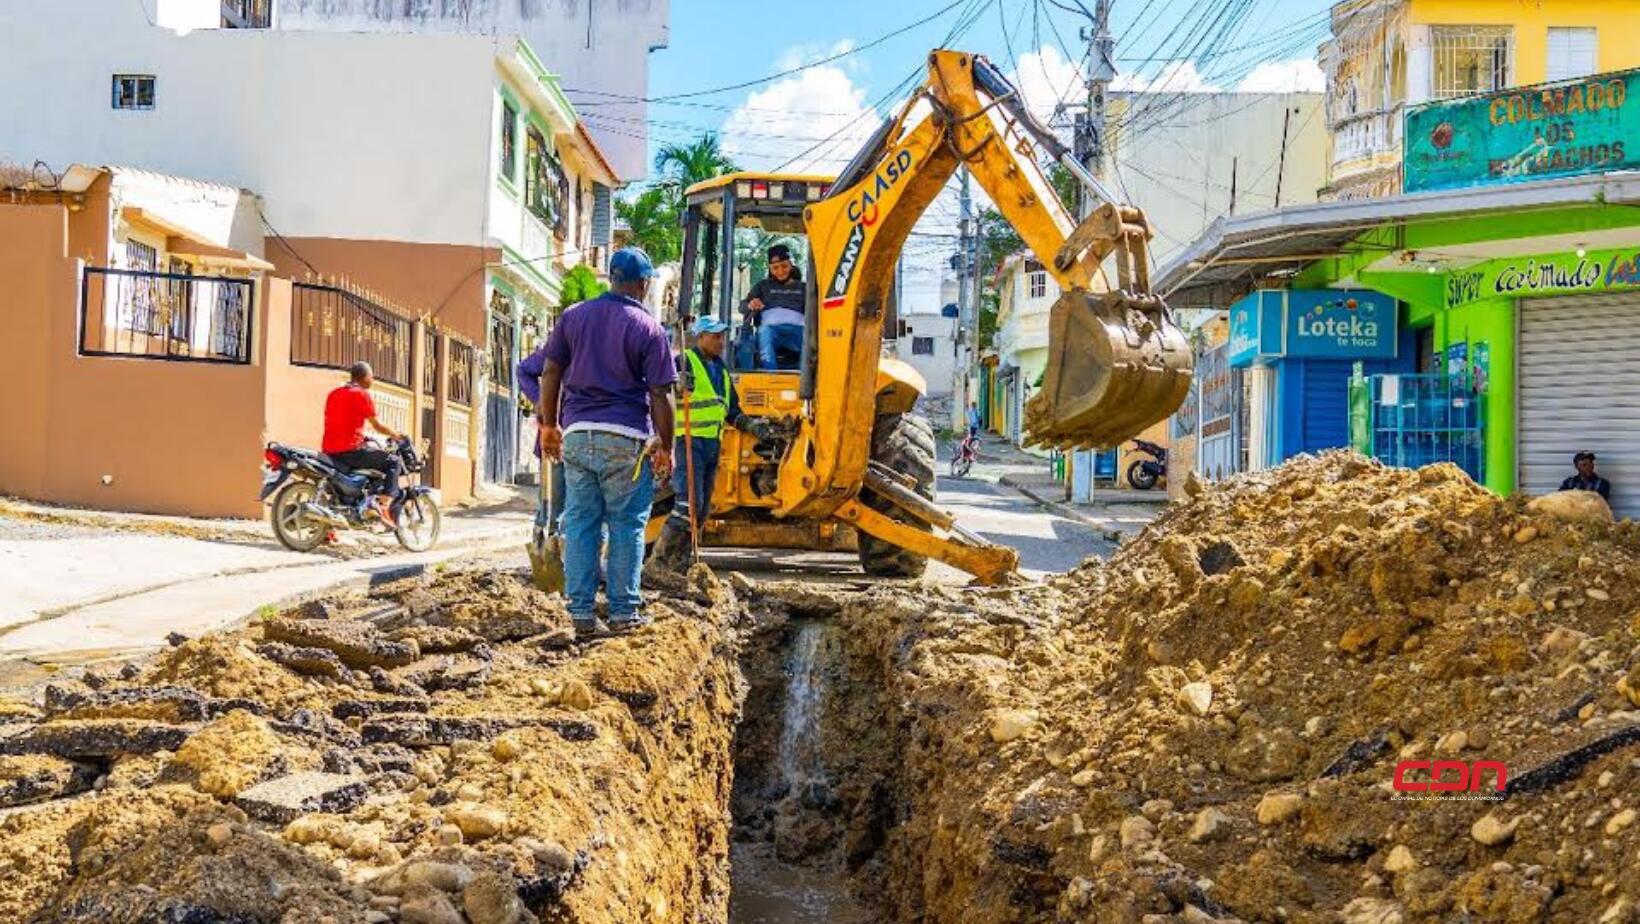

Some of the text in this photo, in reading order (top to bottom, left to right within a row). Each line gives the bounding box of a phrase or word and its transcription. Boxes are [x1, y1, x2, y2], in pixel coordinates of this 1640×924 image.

[1490, 79, 1626, 126] COLMADO
[834, 225, 865, 294] SANY
[1298, 314, 1378, 336] Loteka
[1337, 337, 1377, 347] te toca
